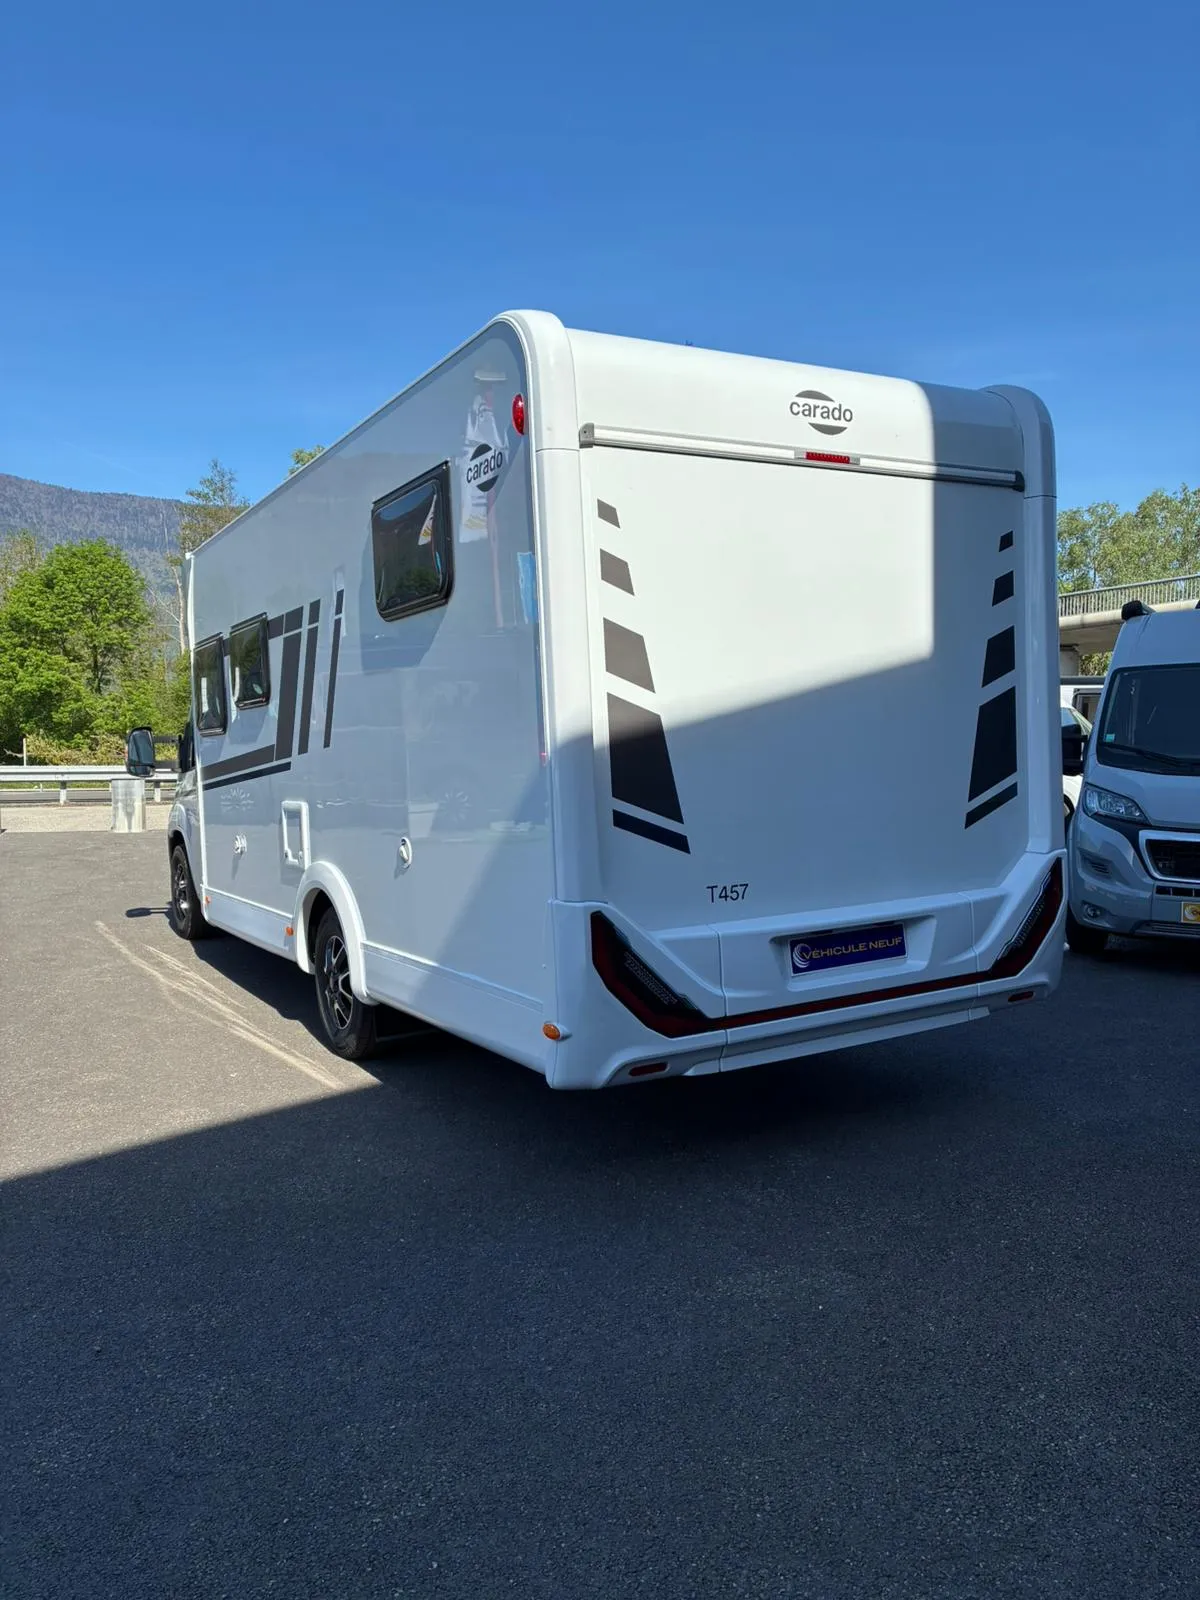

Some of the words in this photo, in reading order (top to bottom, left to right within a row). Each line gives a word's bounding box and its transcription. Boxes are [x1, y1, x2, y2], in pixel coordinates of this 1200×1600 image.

[789, 401, 853, 422] carado
[466, 449, 503, 483] carado
[706, 883, 749, 903] T457
[869, 936, 903, 950] NEUF
